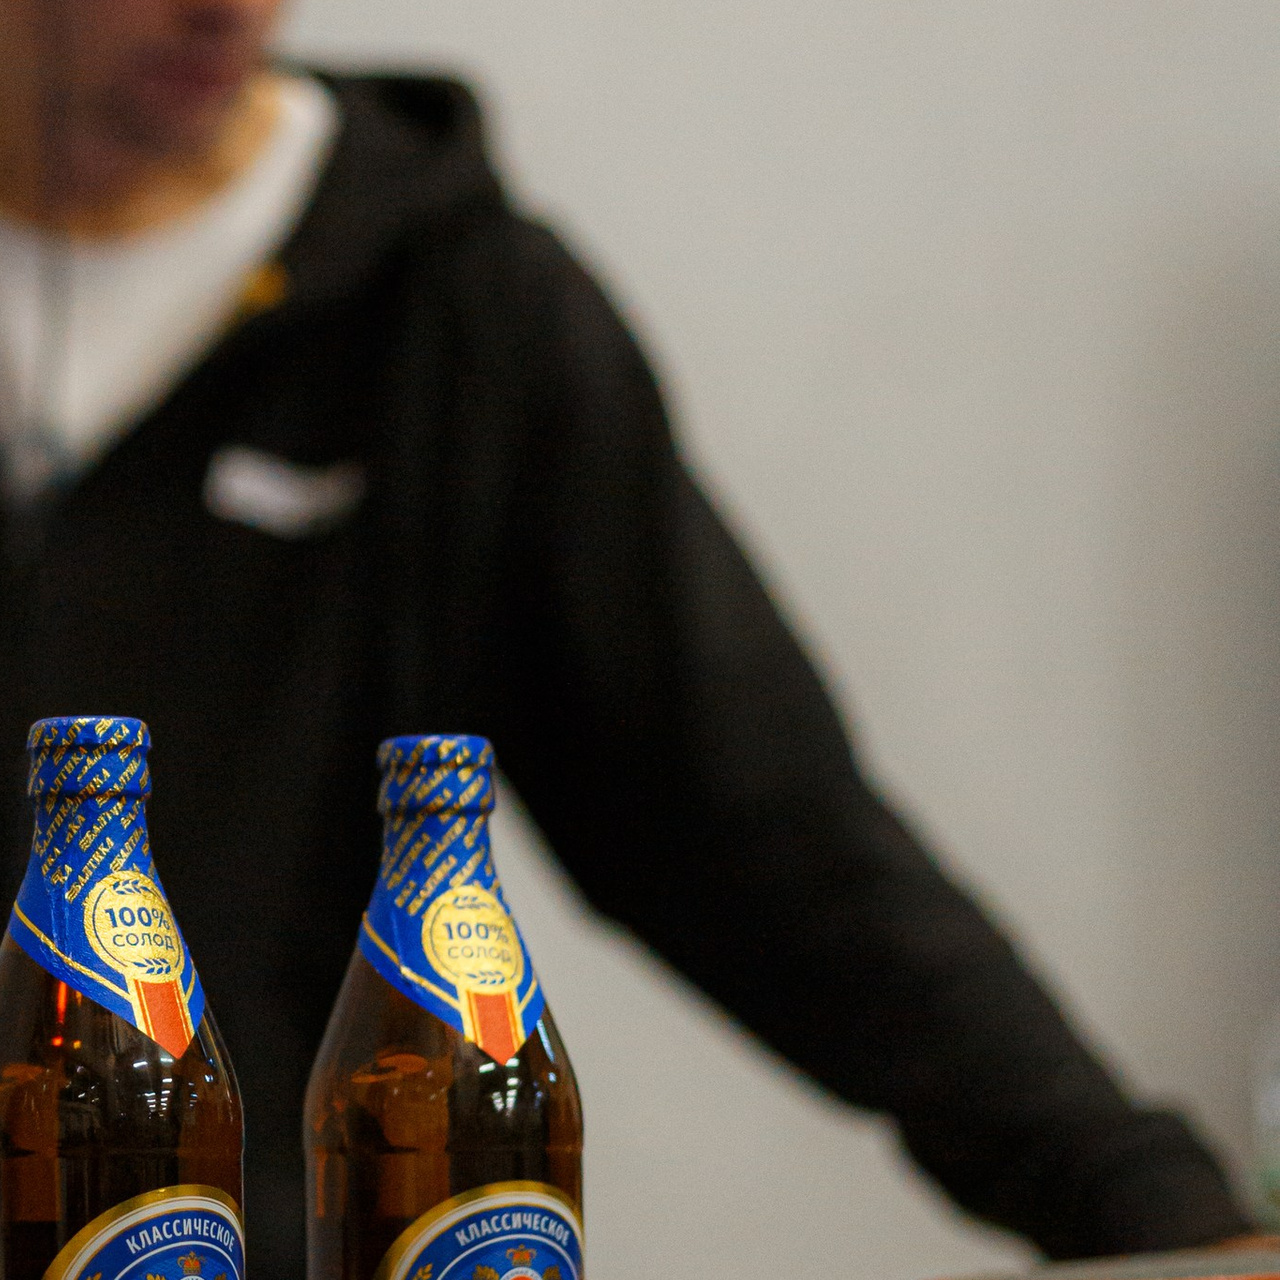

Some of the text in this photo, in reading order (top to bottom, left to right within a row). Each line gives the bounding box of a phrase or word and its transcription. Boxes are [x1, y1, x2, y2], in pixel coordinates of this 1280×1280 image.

[70, 836, 115, 892] БАЛТИКА
[104, 906, 171, 931] 100%
[112, 933, 175, 951] СОЛОД
[442, 921, 509, 944] 100%
[447, 943, 511, 963] СОЛОД
[126, 1218, 235, 1254] КЛАССИЧЕСКОЕ
[455, 1212, 569, 1247] КЛАССИЧЕСКОЕ
